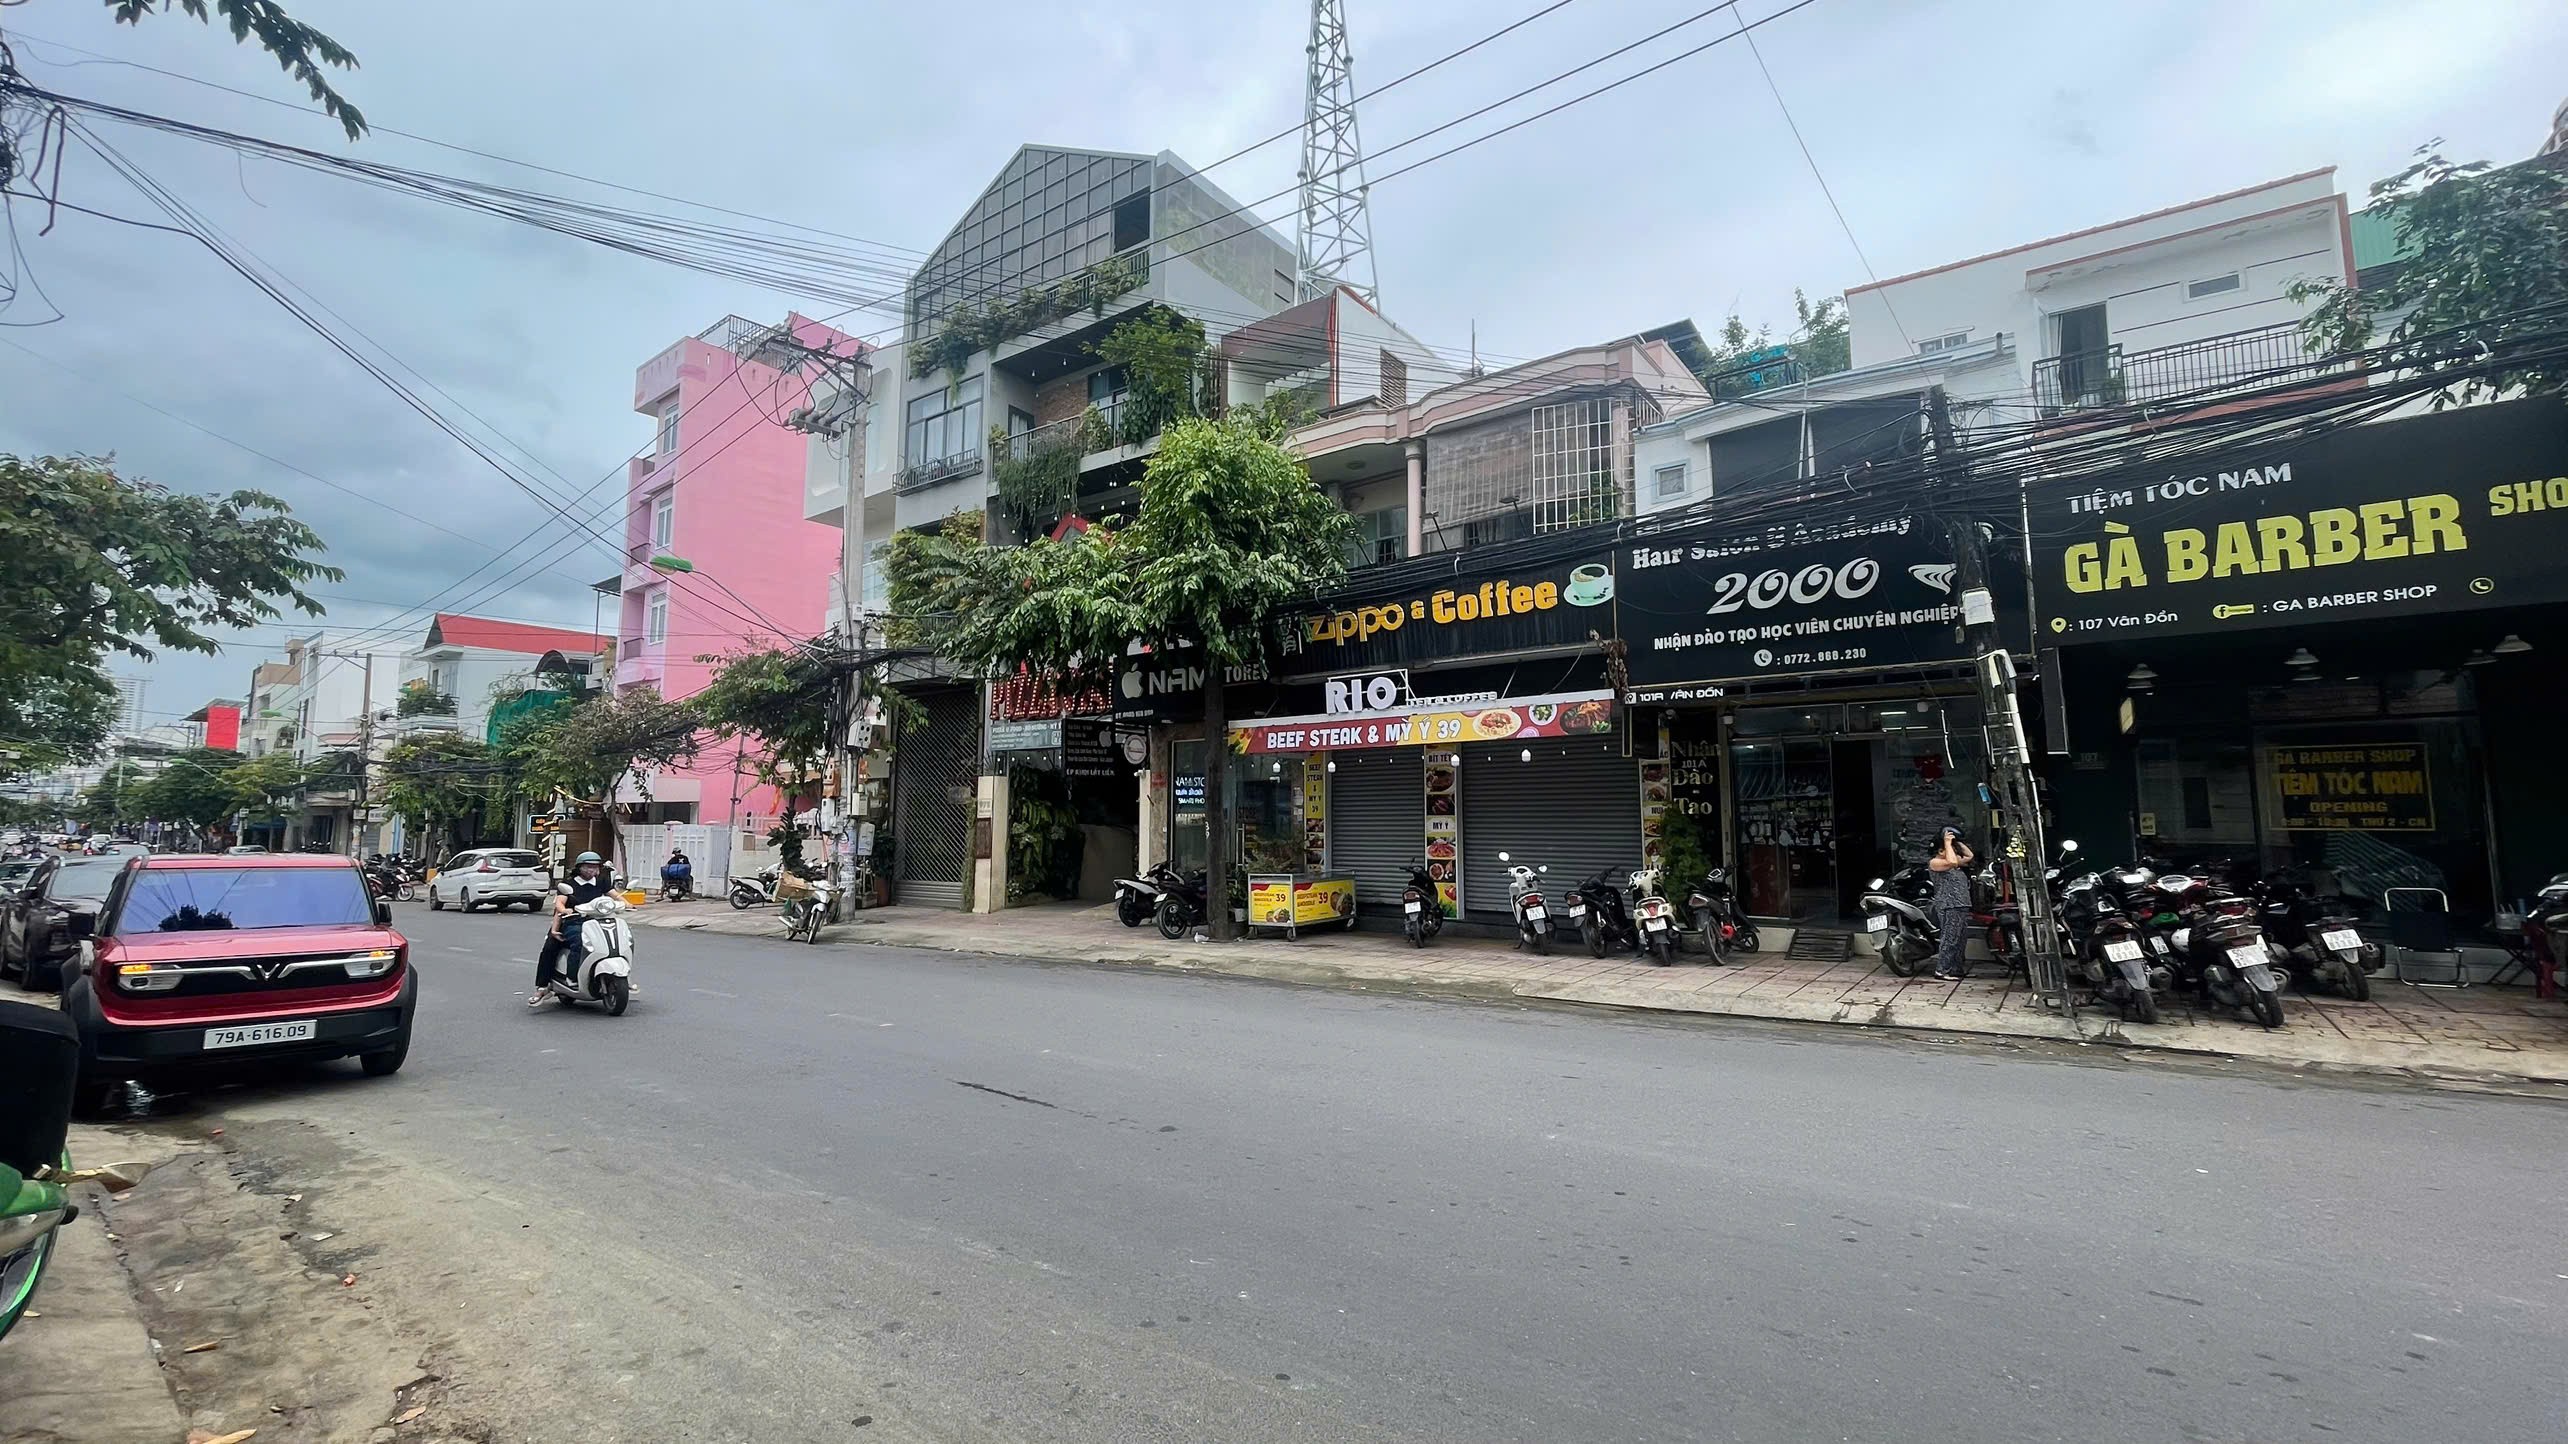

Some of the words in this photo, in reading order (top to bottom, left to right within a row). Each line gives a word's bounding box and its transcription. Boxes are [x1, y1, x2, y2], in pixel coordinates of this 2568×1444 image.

[2065, 487, 2133, 514] TIỆM
[2145, 474, 2210, 502] TÓC
[2218, 462, 2292, 492] NAM
[2064, 521, 2148, 594] GÀ
[2163, 493, 2468, 583] BARBER
[1706, 557, 1880, 615] 2000
[2272, 598, 2303, 613] GA
[2308, 590, 2378, 609] BARBER
[2383, 584, 2438, 602] SHOP
[1431, 580, 1558, 624] Coffee
[1654, 632, 1691, 652] NHẬN
[1694, 628, 1725, 647] ĐÀO
[1728, 628, 1758, 646] TẠO
[1761, 623, 1792, 642] HỌC
[1795, 617, 1831, 635] VIÊN
[1833, 608, 1896, 632] CHUYÊN
[2078, 619, 2103, 631] 107
[2108, 615, 2140, 628] Vân
[2144, 609, 2178, 624] Đồn
[1325, 676, 1397, 715] RIO
[1267, 730, 1304, 750] BEEF
[1309, 724, 1363, 747] STEAK
[1367, 725, 1380, 744] &
[1385, 717, 1413, 742] MỲ
[1418, 716, 1432, 741] Ý
[1436, 719, 1461, 739] 39
[2299, 750, 2365, 764] BARBER
[2370, 749, 2416, 763] SHOP
[2372, 770, 2424, 795] NAM
[2310, 801, 2388, 813] OPENING
[1275, 893, 1286, 902] 39
[1318, 891, 1329, 904] 39
[215, 1025, 307, 1045] 79A-616.09
